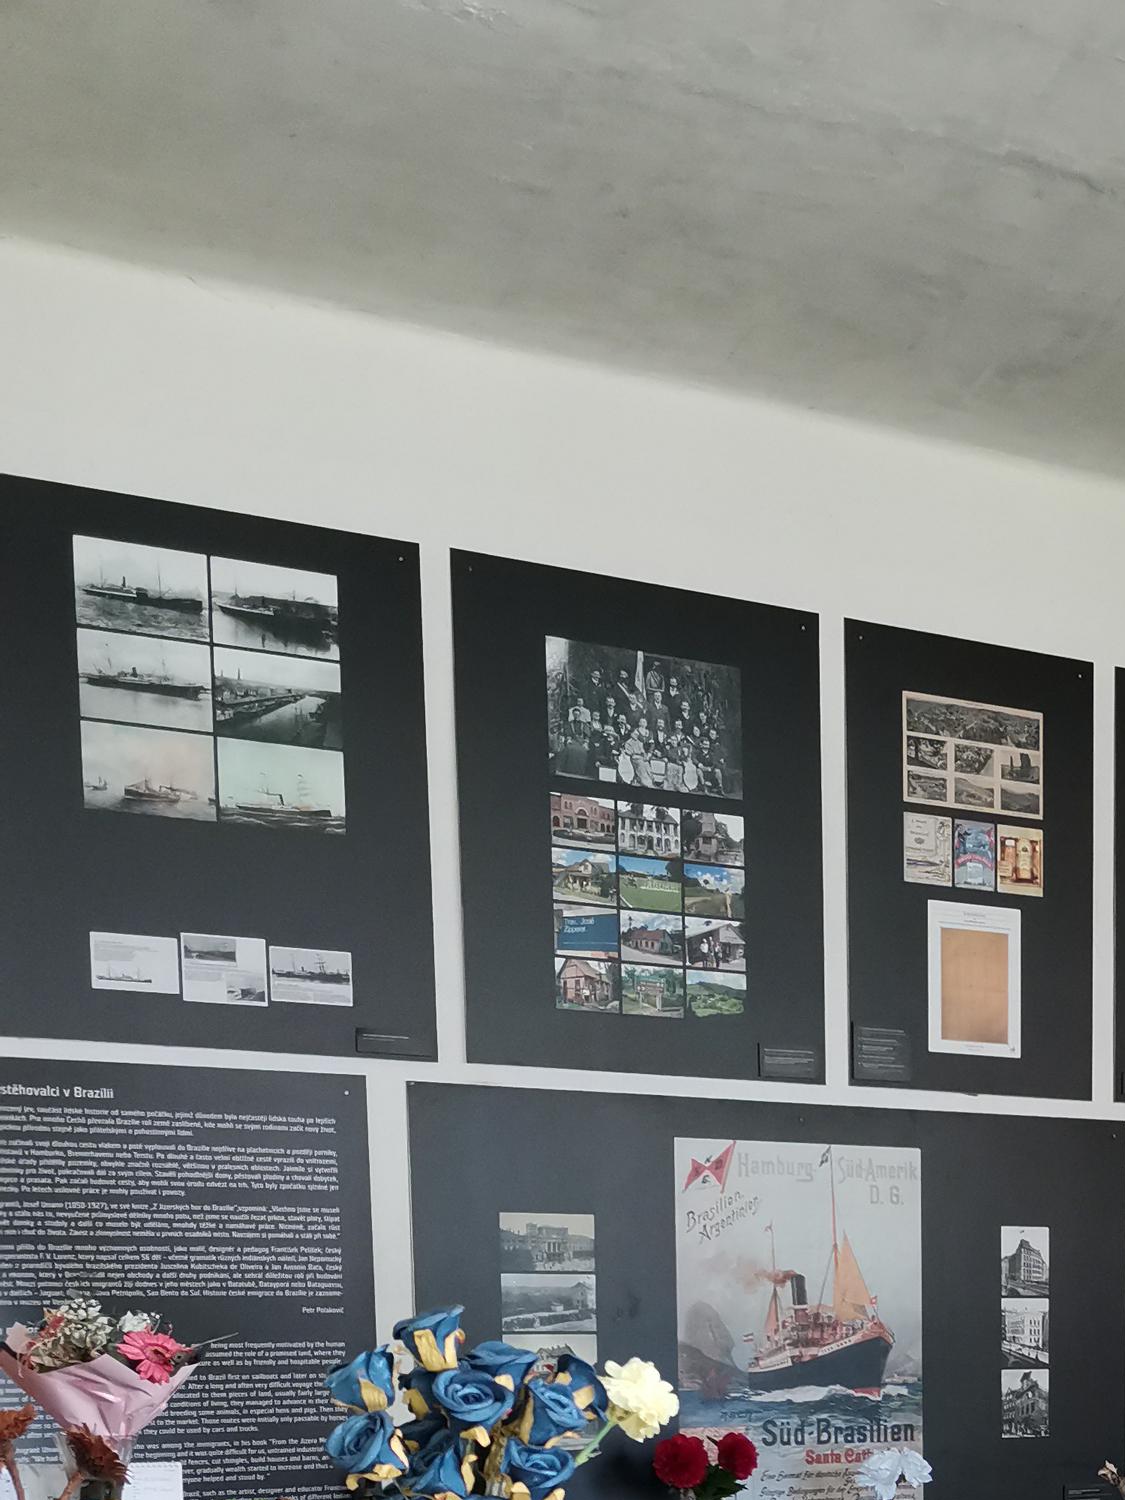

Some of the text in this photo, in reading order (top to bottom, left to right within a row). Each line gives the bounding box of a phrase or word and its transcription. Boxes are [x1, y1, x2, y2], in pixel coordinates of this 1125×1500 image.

[0, 1084, 60, 1098] stěhovalci
[63, 1089, 70, 1098] v
[177, 1450, 188, 1458] and
